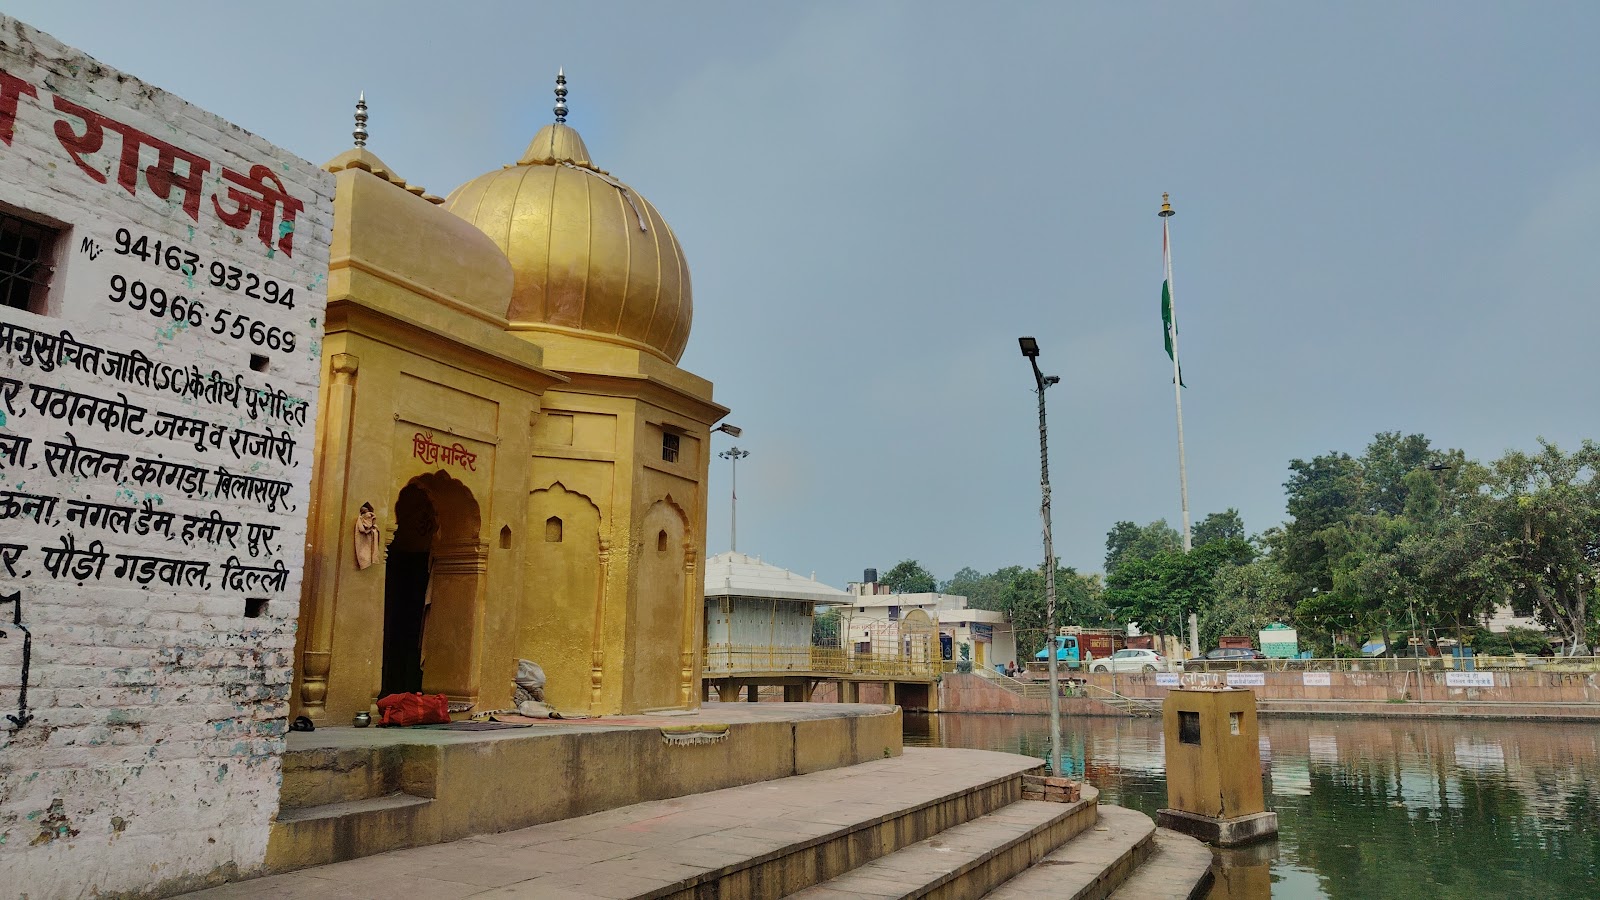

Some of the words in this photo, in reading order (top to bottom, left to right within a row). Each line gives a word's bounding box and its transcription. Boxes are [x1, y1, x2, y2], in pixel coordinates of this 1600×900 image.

[244, 383, 309, 427] पुरोहित
[44, 432, 129, 483] सोलन,
[132, 454, 209, 498] कांगड़ा,
[214, 466, 296, 513] बिलासपुर,
[229, 427, 299, 468] राजोरी,
[66, 494, 136, 534] नंगल
[181, 510, 241, 548] हमीर
[41, 533, 109, 586] पौड़ी
[220, 555, 289, 593] दिल्ली
